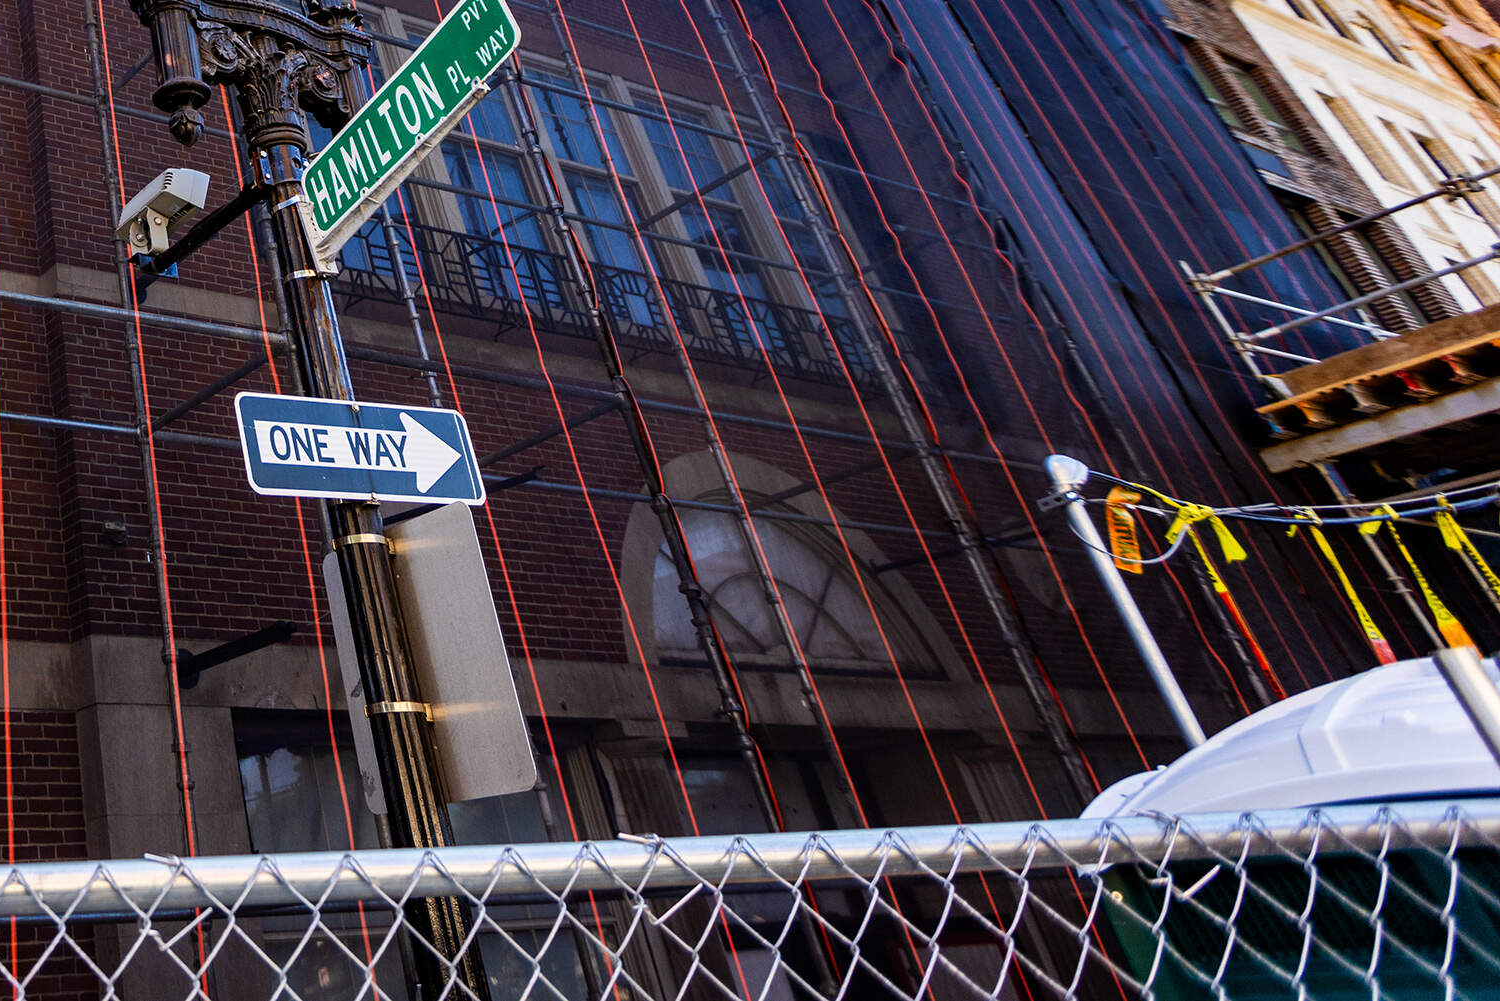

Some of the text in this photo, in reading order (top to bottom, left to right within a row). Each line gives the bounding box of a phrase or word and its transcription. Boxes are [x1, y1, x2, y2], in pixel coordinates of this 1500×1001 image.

[475, 25, 508, 67] WAY
[310, 60, 471, 223] HAMILTON PL
[269, 425, 407, 468] ONE WAY
